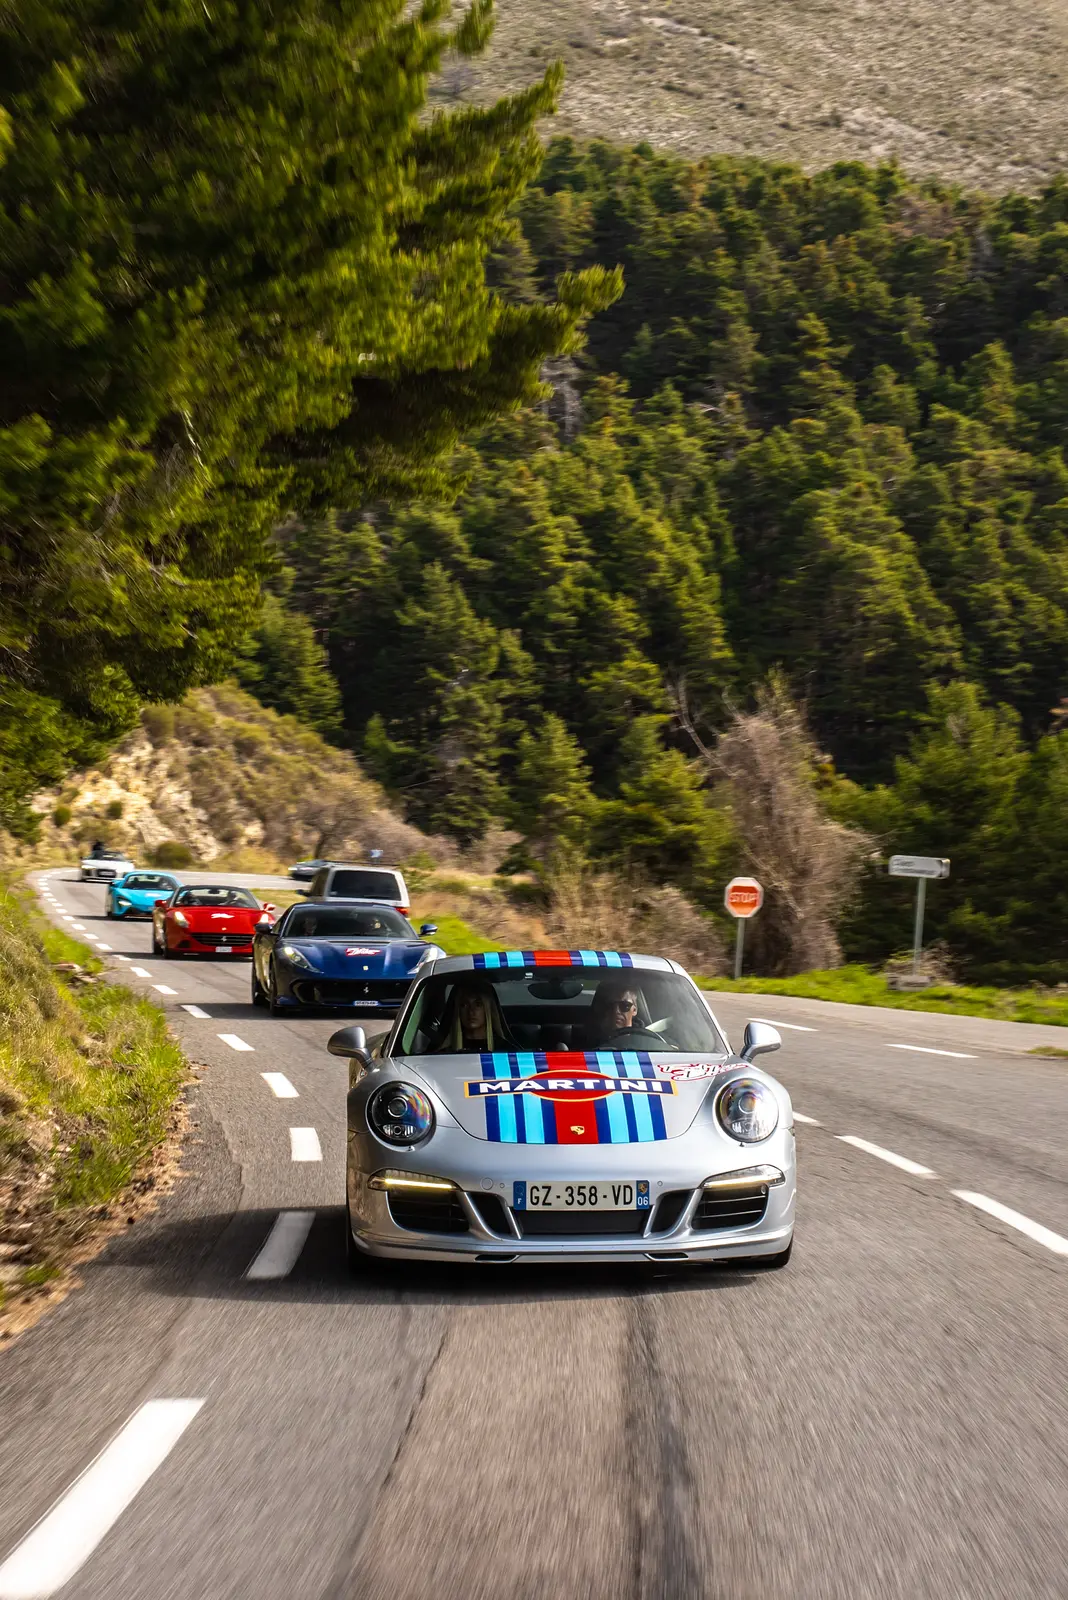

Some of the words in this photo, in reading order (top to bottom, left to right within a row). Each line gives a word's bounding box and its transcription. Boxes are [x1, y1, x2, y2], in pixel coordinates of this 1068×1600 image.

[729, 892, 758, 903] STOP
[479, 1079, 663, 1094] MARTINI
[637, 1196, 649, 1206] 06
